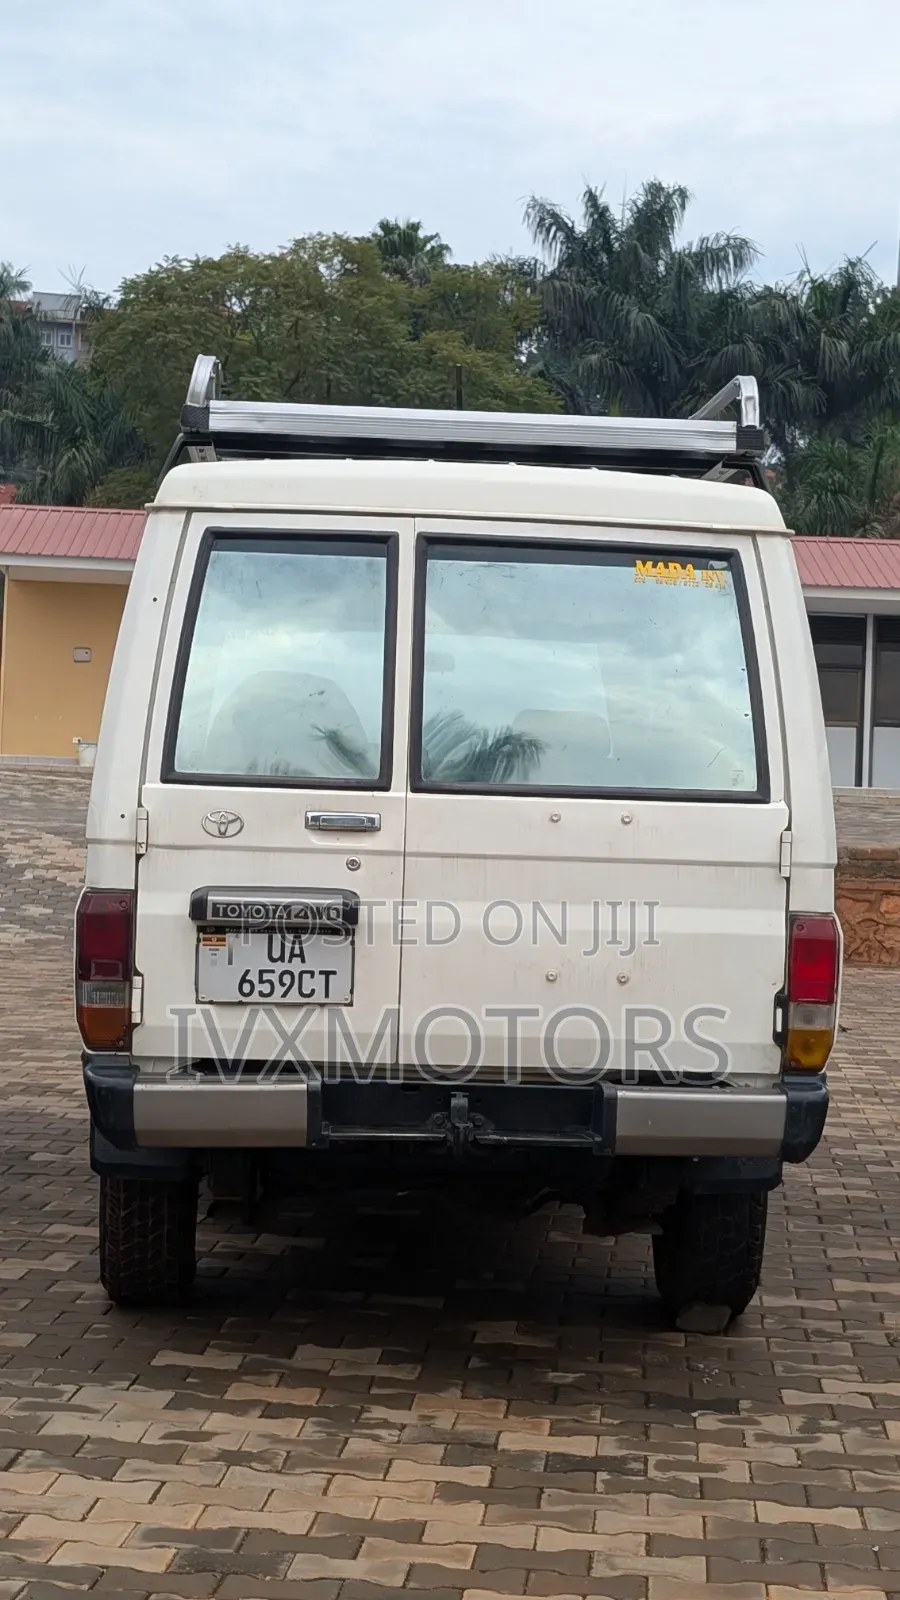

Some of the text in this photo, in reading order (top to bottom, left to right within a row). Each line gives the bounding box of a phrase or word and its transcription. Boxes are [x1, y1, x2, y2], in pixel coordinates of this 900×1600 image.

[635, 560, 696, 579] MADA
[216, 904, 341, 920] TOYOTA 4WD
[267, 934, 307, 964] UA
[237, 969, 337, 999] 659CT
